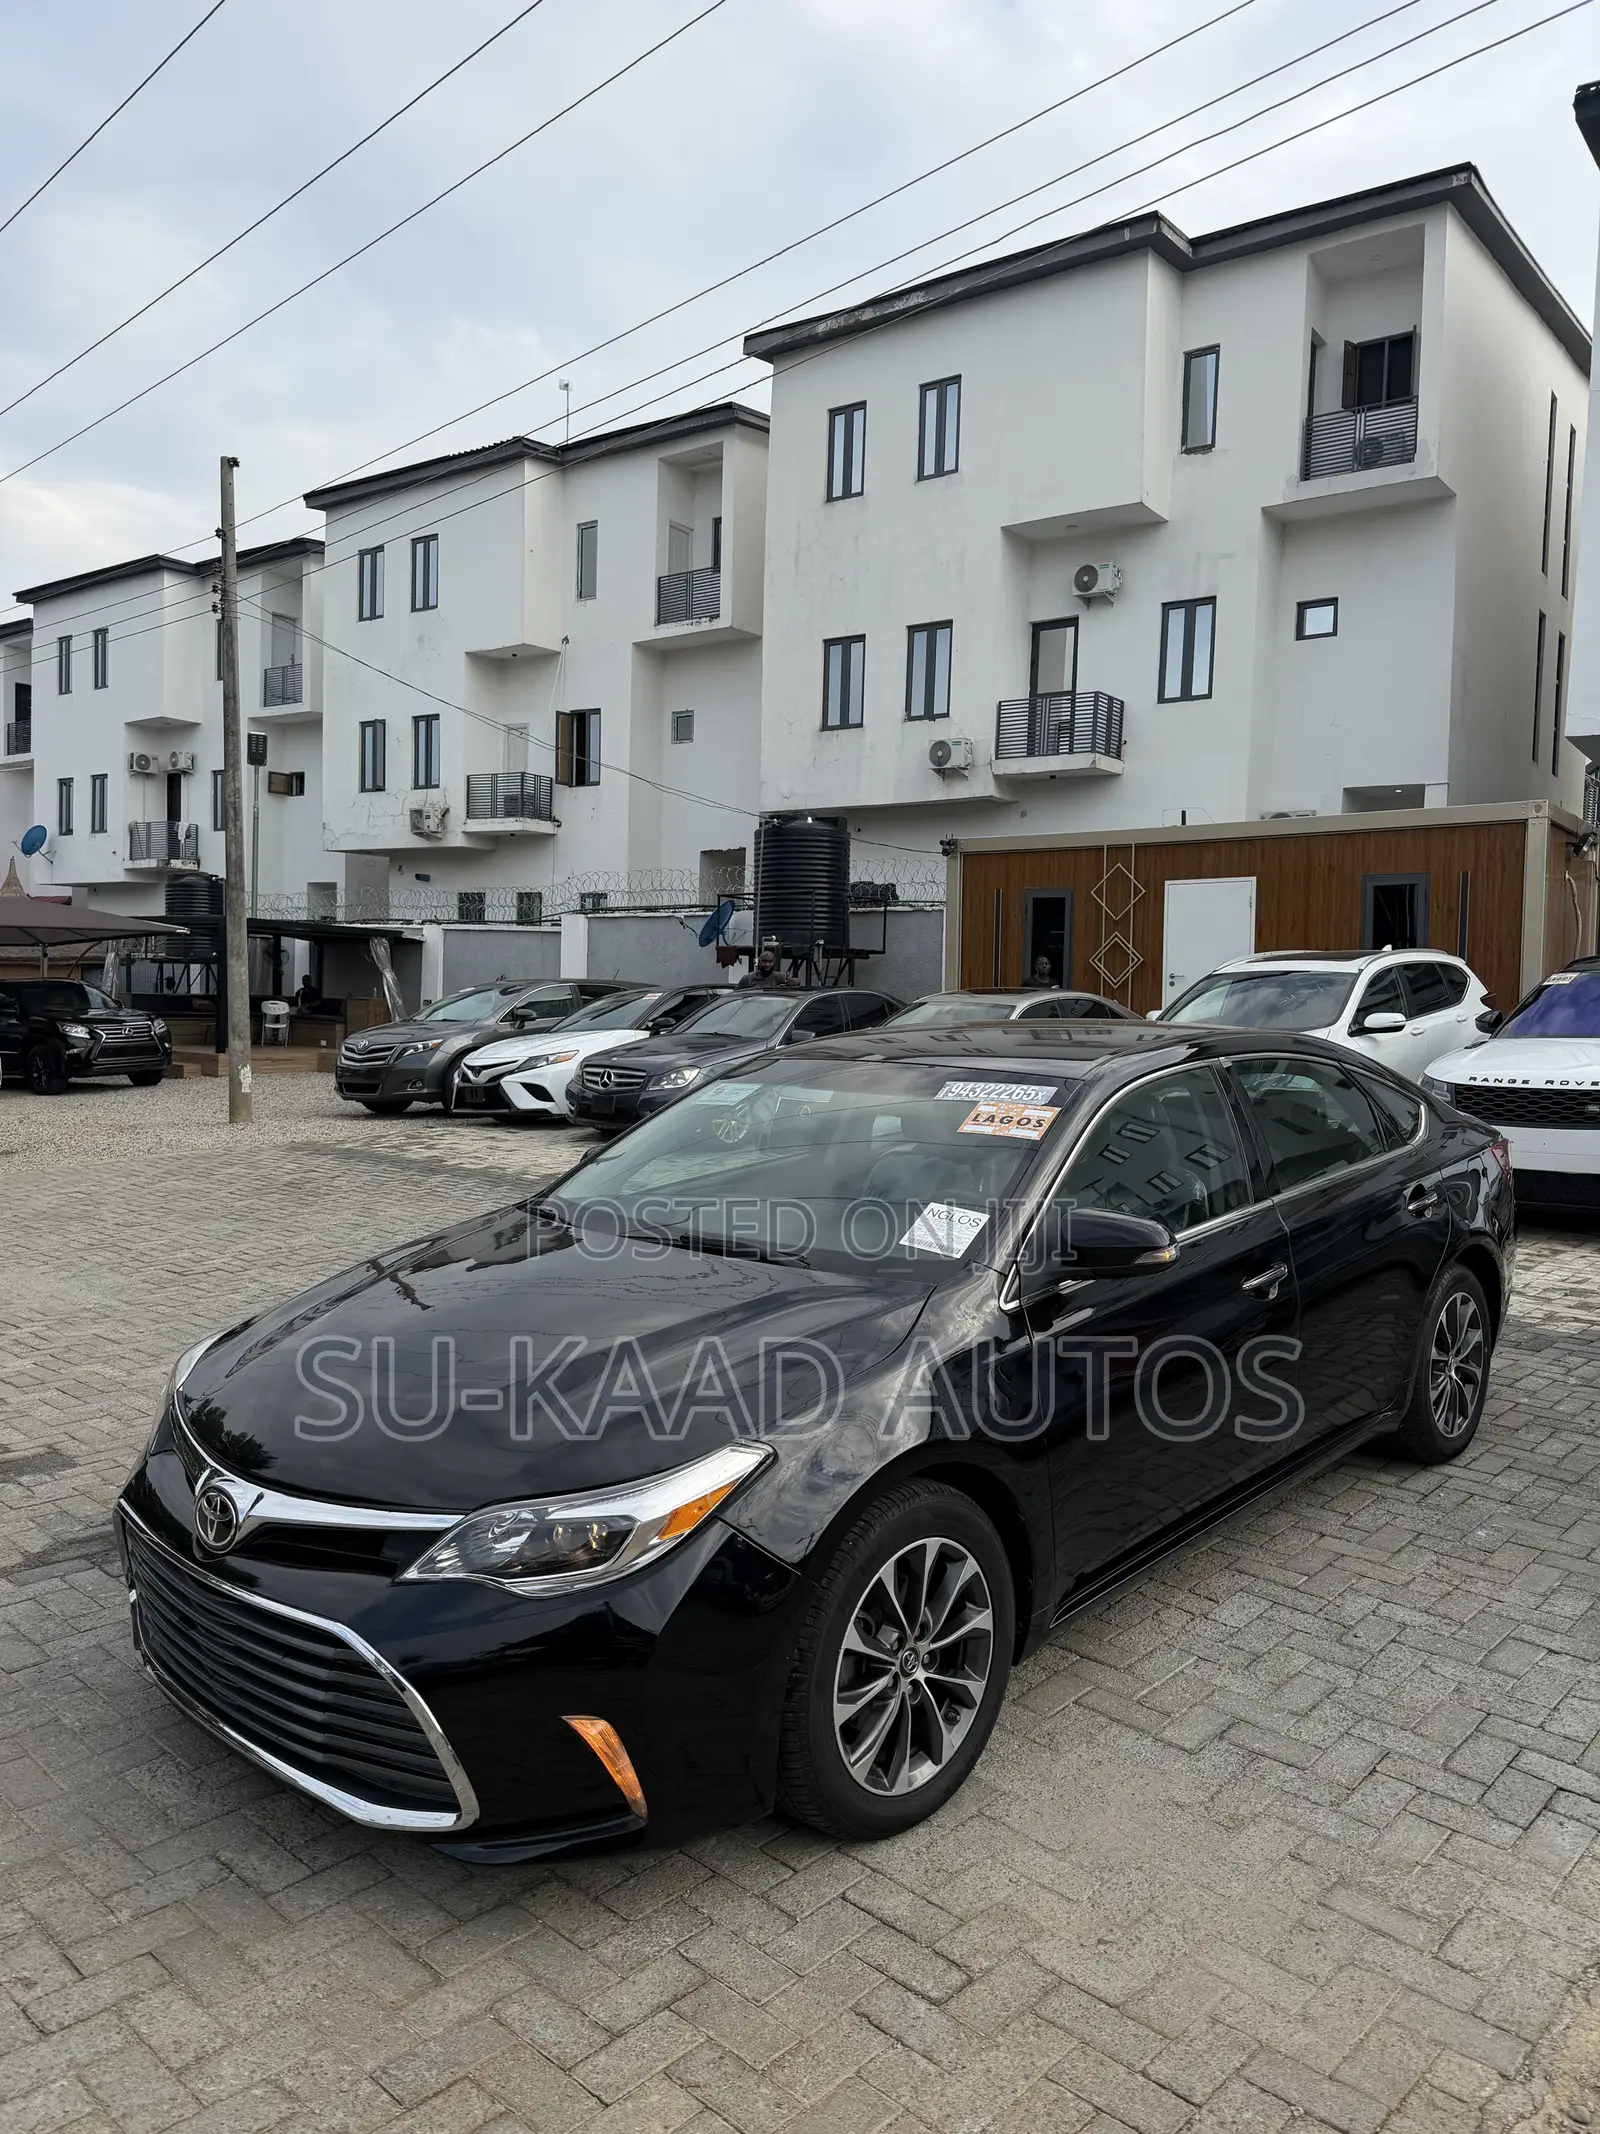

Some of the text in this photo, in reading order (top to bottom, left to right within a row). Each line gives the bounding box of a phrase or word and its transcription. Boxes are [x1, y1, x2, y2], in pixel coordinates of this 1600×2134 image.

[1468, 1076, 1531, 1085] RANGE
[971, 1113, 1046, 1129] LAGOS
[926, 1207, 983, 1228] NGLOS
